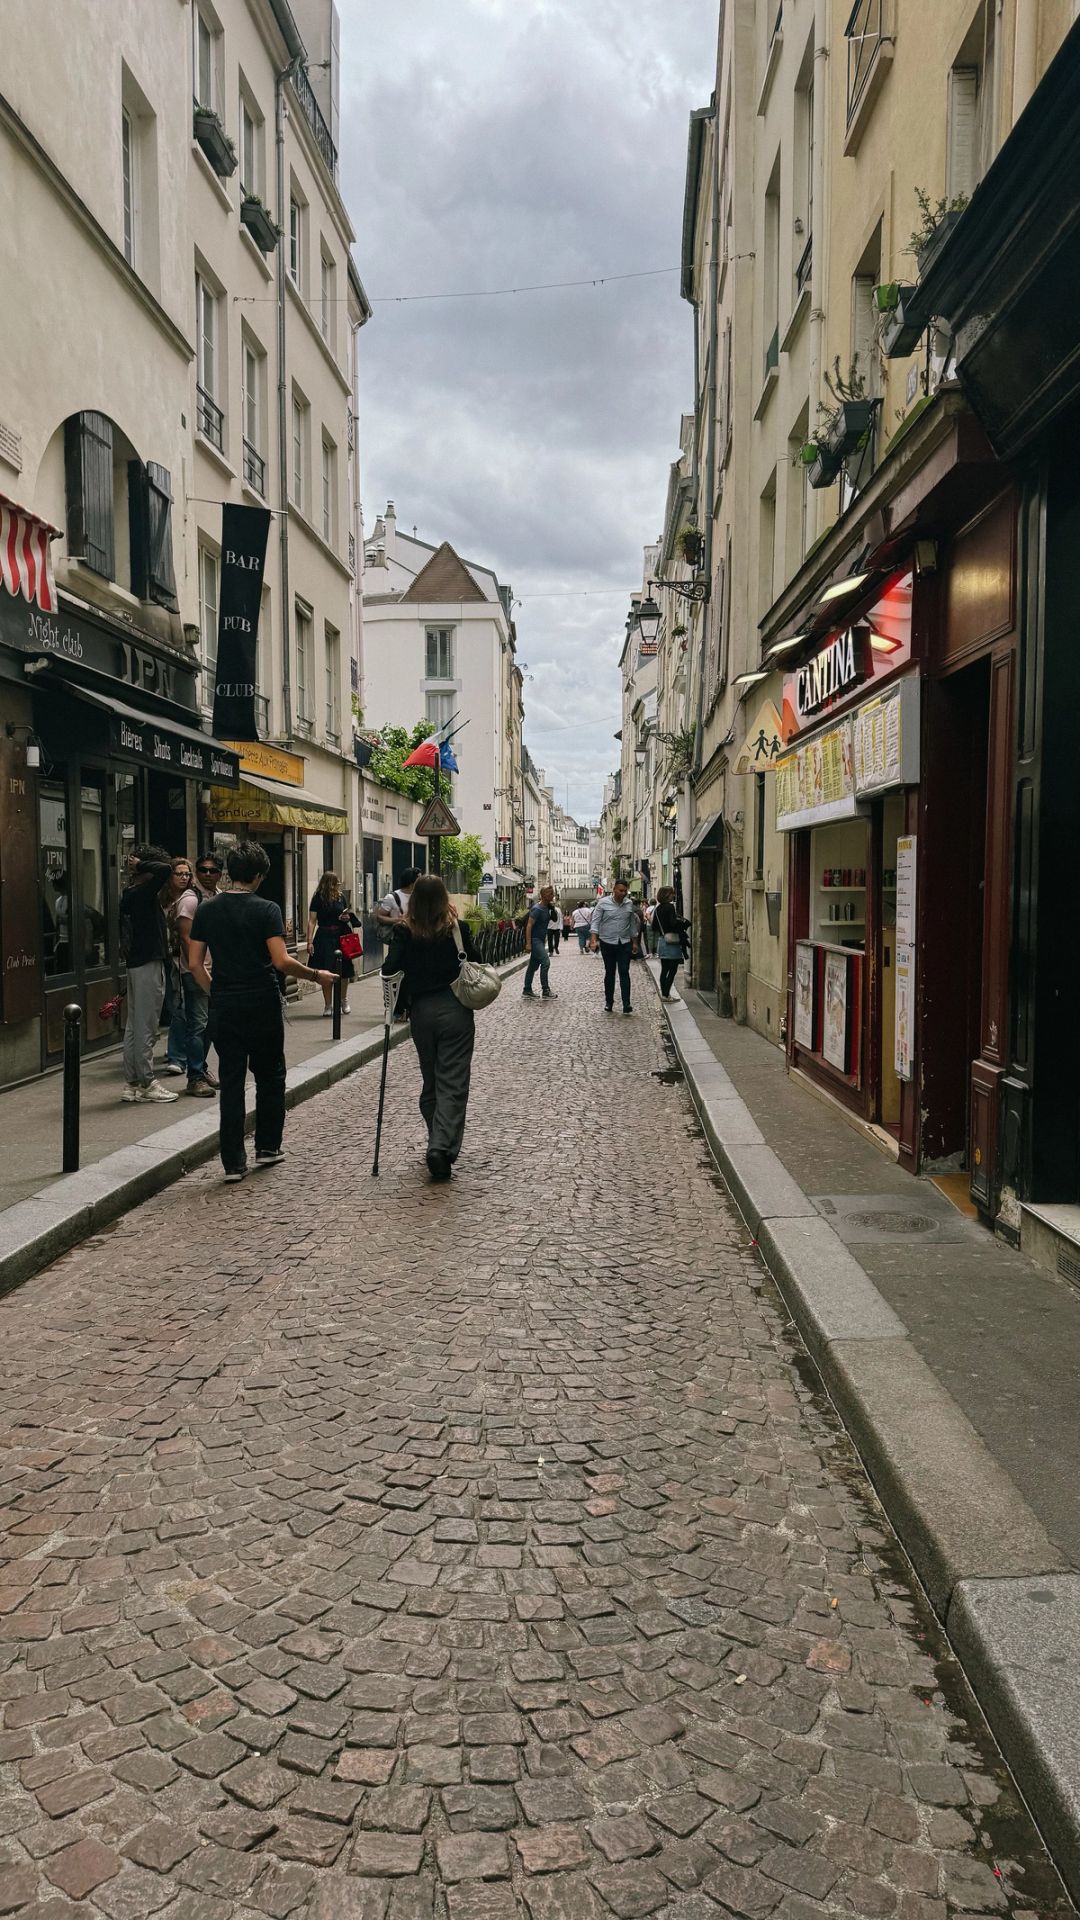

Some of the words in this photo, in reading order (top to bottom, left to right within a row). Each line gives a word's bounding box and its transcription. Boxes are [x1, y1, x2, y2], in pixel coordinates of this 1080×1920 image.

[225, 550, 261, 572] BAR
[223, 616, 250, 633] PUB
[29, 613, 60, 648] Night
[62, 631, 84, 659] club
[120, 642, 177, 699] IPN
[797, 627, 857, 717] CANTINA
[216, 683, 255, 698] CLUB
[120, 721, 143, 752] Bières
[153, 734, 171, 761] Shots
[180, 743, 204, 769] Cocktails
[9, 778, 25, 796] IPN
[210, 807, 262, 819] Fondues
[46, 851, 63, 865] IPN
